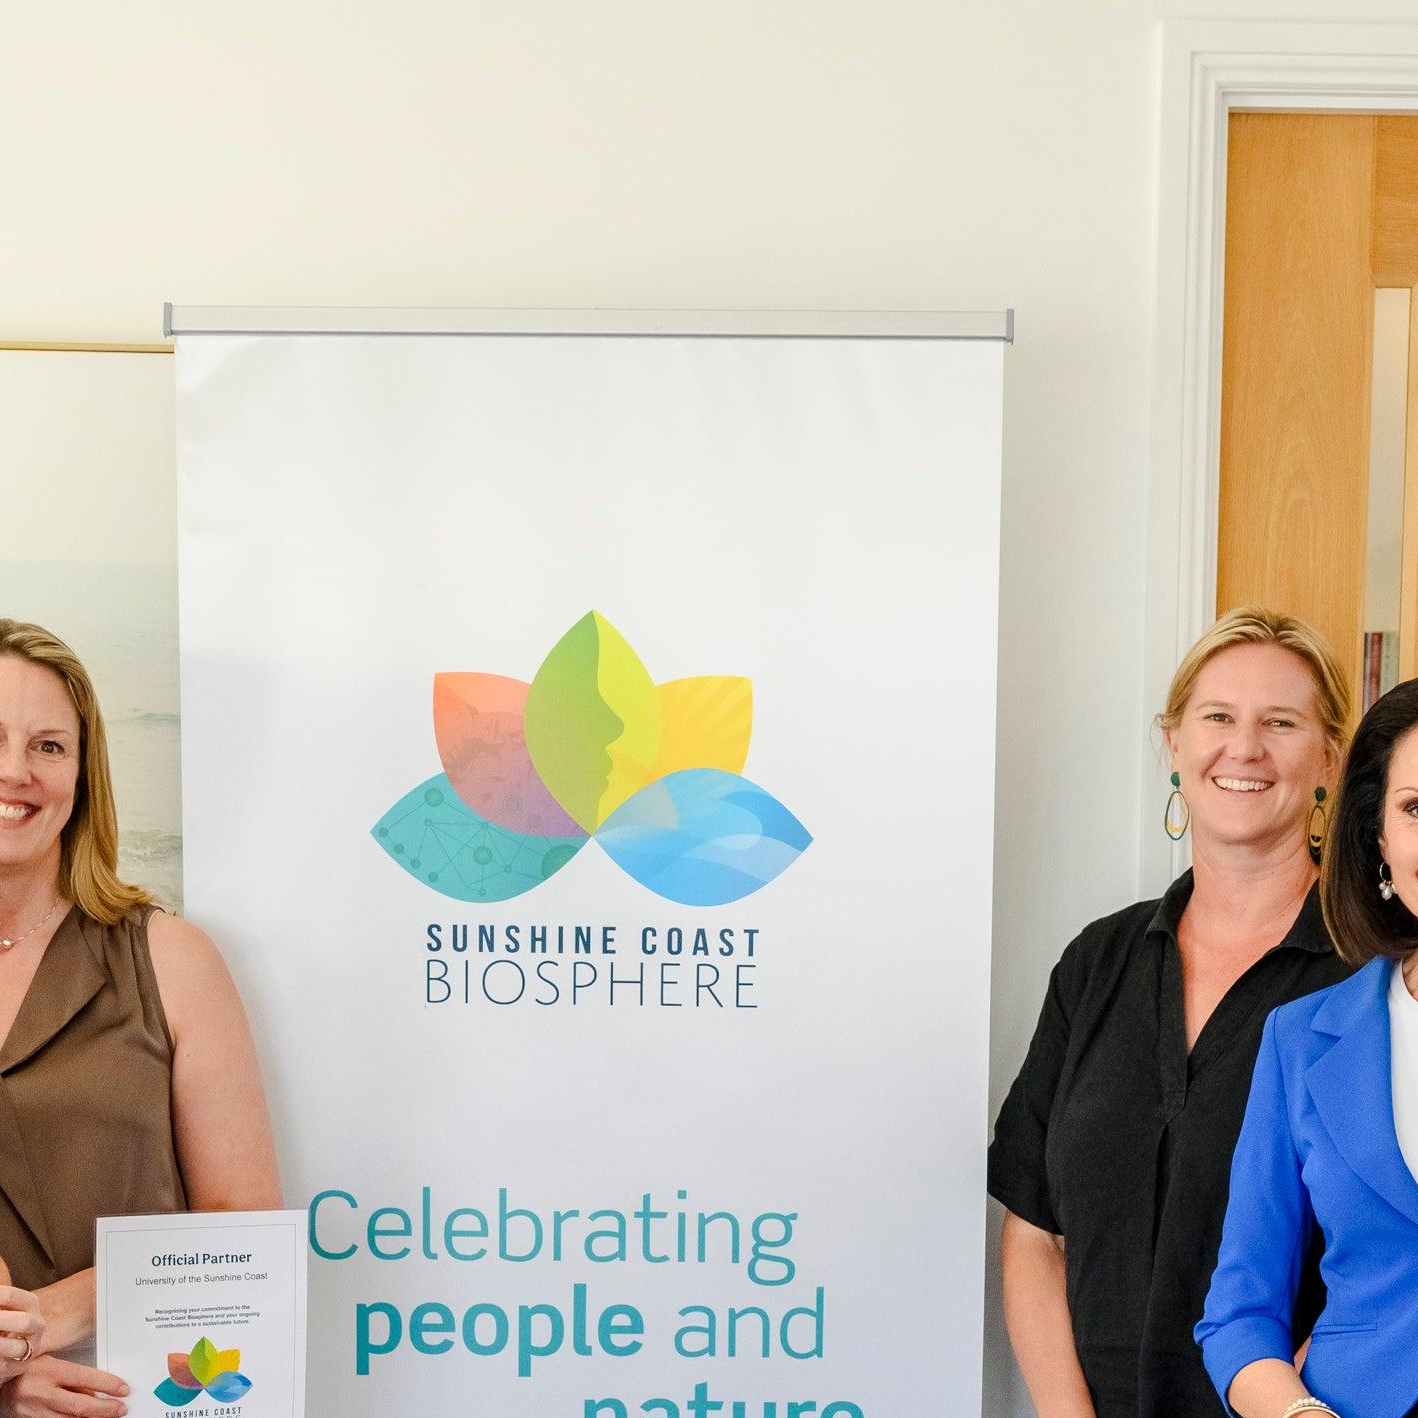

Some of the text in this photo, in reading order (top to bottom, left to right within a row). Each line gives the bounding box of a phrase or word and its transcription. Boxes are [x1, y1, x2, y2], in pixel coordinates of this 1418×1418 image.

[427, 923, 759, 957] SUNSHINE COAST
[426, 959, 758, 1008] BIOSPHERE
[308, 1186, 798, 1287] Celebrating
[152, 1253, 252, 1267] Official Partner
[135, 1277, 175, 1286] University
[204, 1274, 241, 1282] Sunshine
[244, 1272, 268, 1280] Coast
[356, 1283, 825, 1378] people and
[165, 1407, 241, 1418] SUNSHINE COAST
